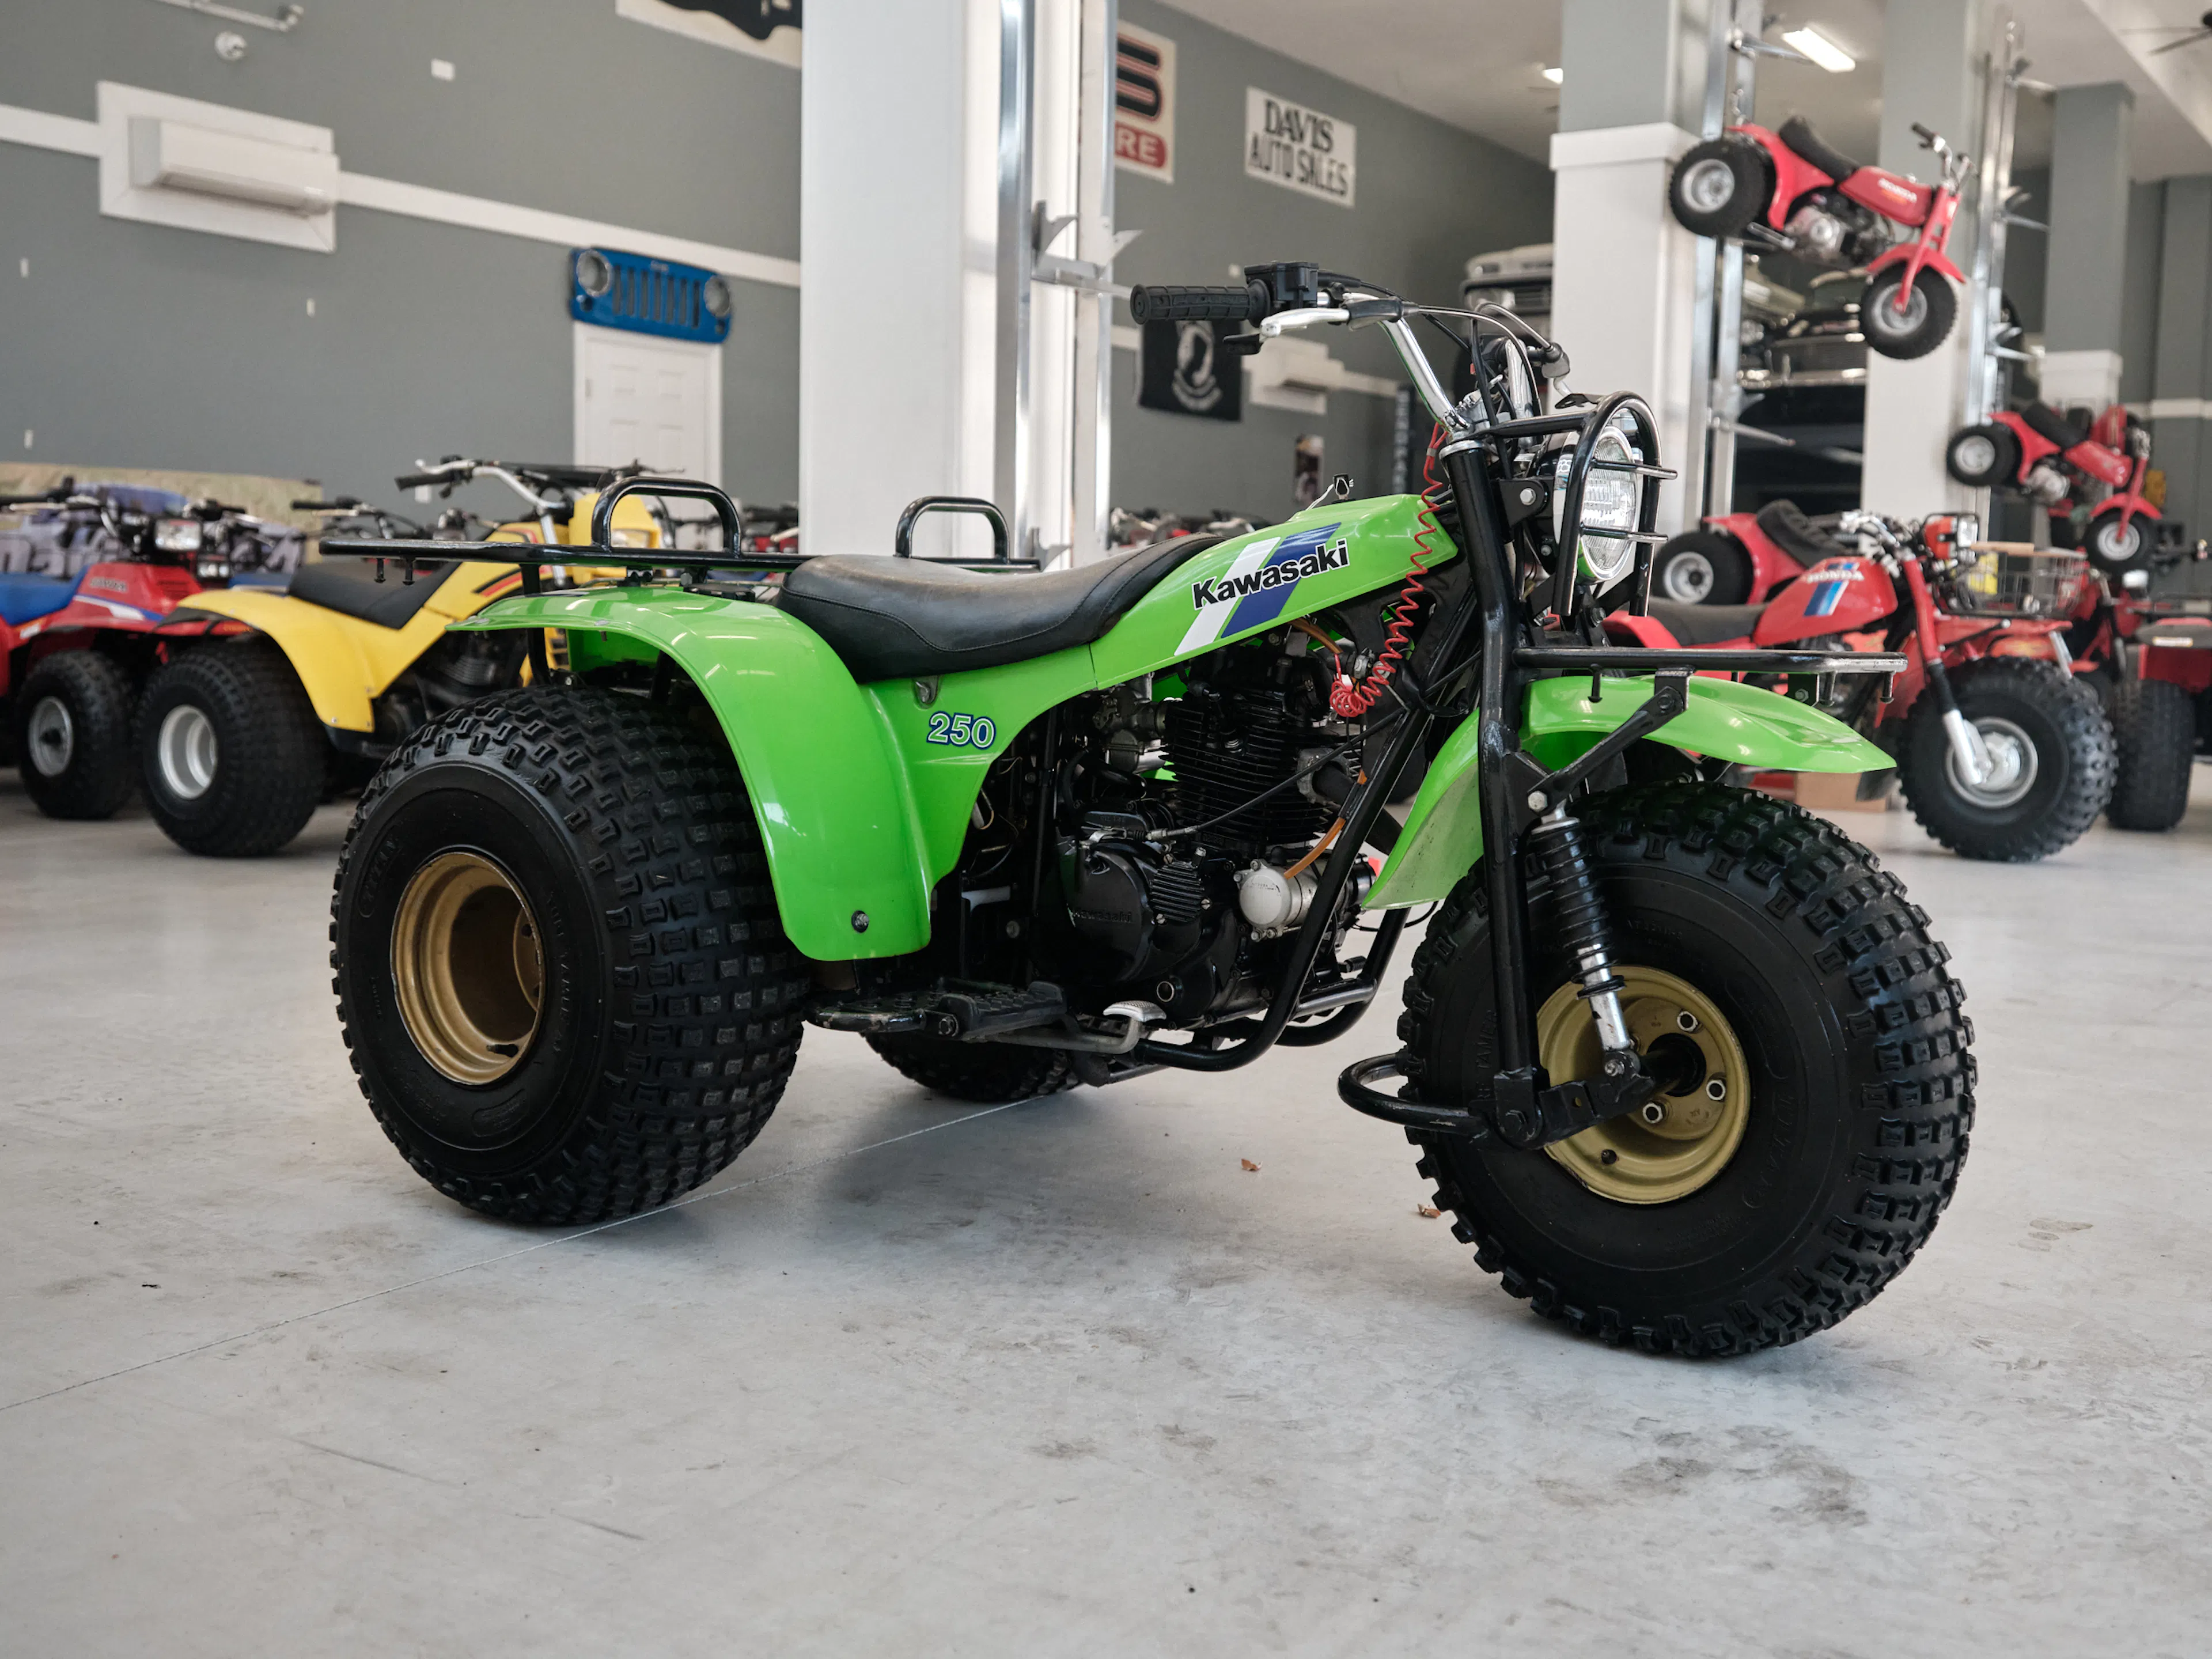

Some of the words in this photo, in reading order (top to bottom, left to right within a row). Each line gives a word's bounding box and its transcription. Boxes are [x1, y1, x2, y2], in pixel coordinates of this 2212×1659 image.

[1266, 98, 1334, 153] DAVIS
[1249, 132, 1295, 180] AUTO
[1296, 148, 1349, 198] SALES
[1192, 538, 1349, 610] Kawasaki
[926, 711, 996, 750] 250
